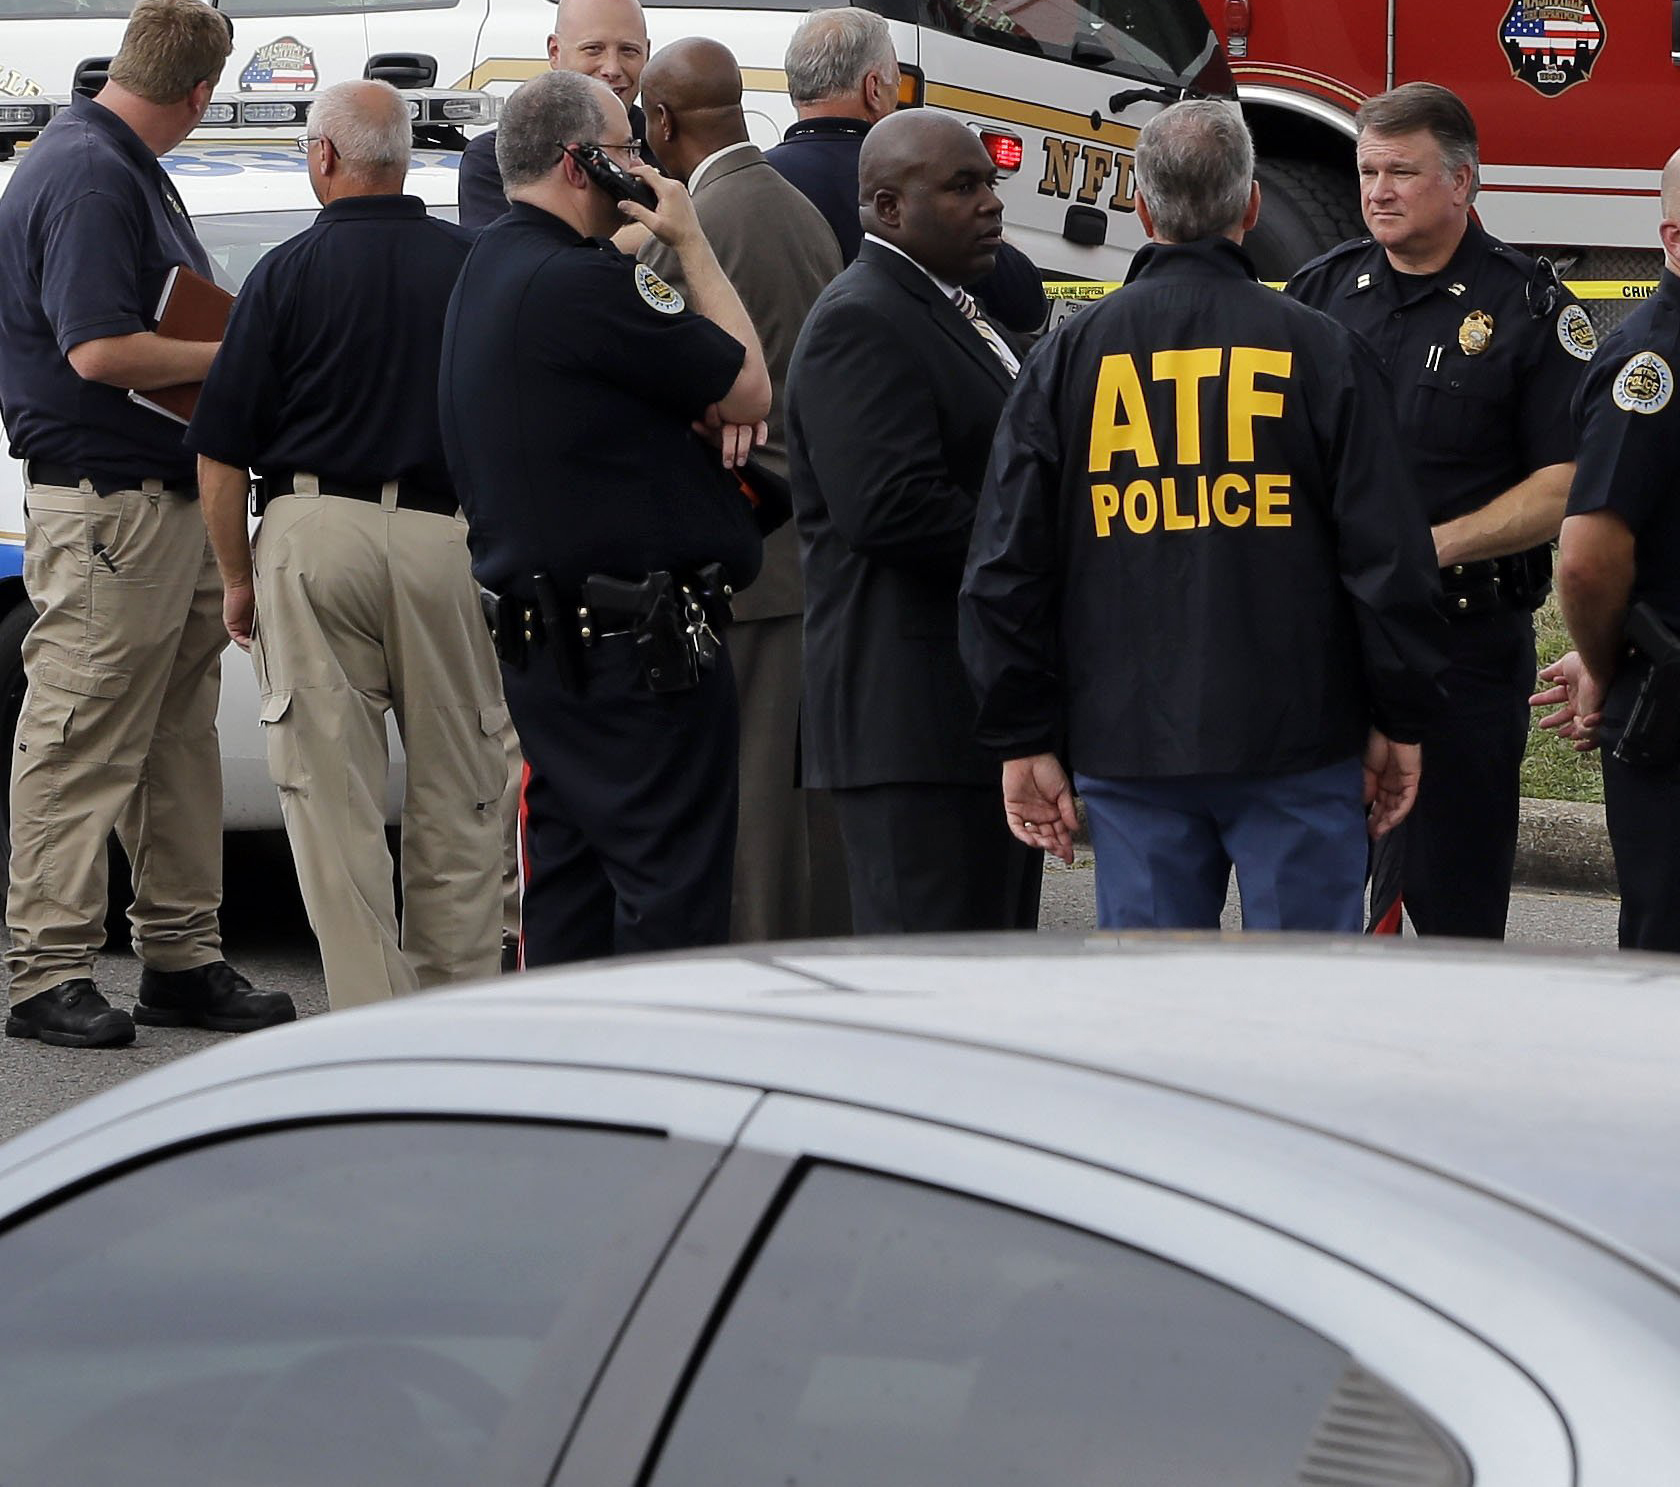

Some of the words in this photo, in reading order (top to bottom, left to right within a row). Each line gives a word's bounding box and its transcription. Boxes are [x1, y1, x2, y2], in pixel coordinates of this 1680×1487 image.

[1037, 136, 1136, 213] NFD
[1622, 285, 1659, 298] CRIM
[1088, 346, 1293, 472] ATF
[1625, 375, 1660, 393] POLICE
[1090, 472, 1293, 538] POLICE
